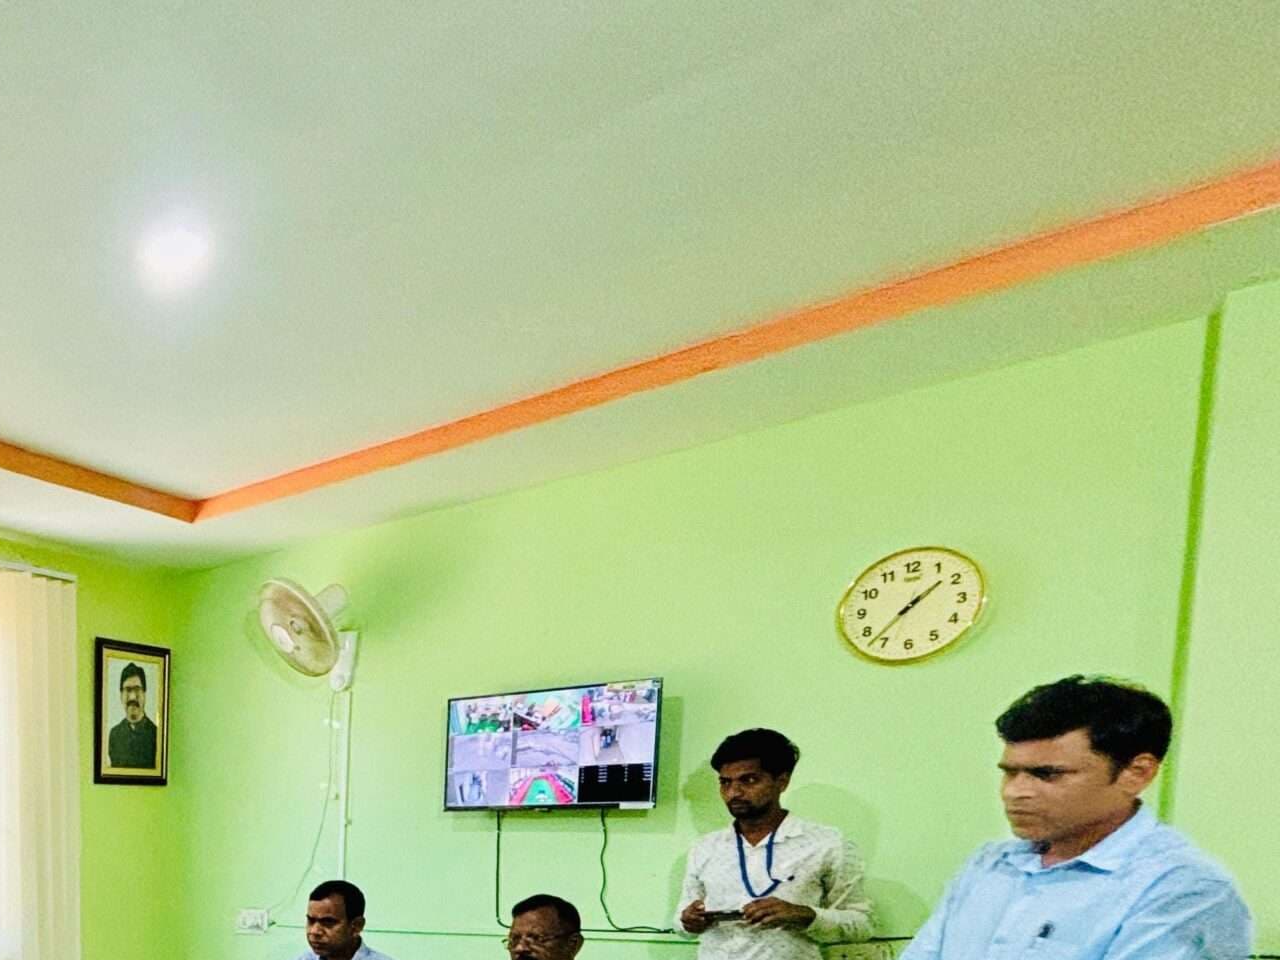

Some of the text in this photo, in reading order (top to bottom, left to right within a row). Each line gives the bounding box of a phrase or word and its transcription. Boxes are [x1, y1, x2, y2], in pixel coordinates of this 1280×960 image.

[904, 560, 921, 574] 12
[935, 562, 942, 574] 1
[881, 570, 895, 583] 11
[950, 573, 961, 585] 2
[862, 588, 879, 600] 10
[956, 592, 967, 604] 3
[857, 608, 867, 620] 9
[948, 612, 959, 624] 4
[862, 626, 872, 637] 8
[929, 630, 939, 641] 5
[879, 637, 889, 649] 7
[903, 639, 914, 650] 6
